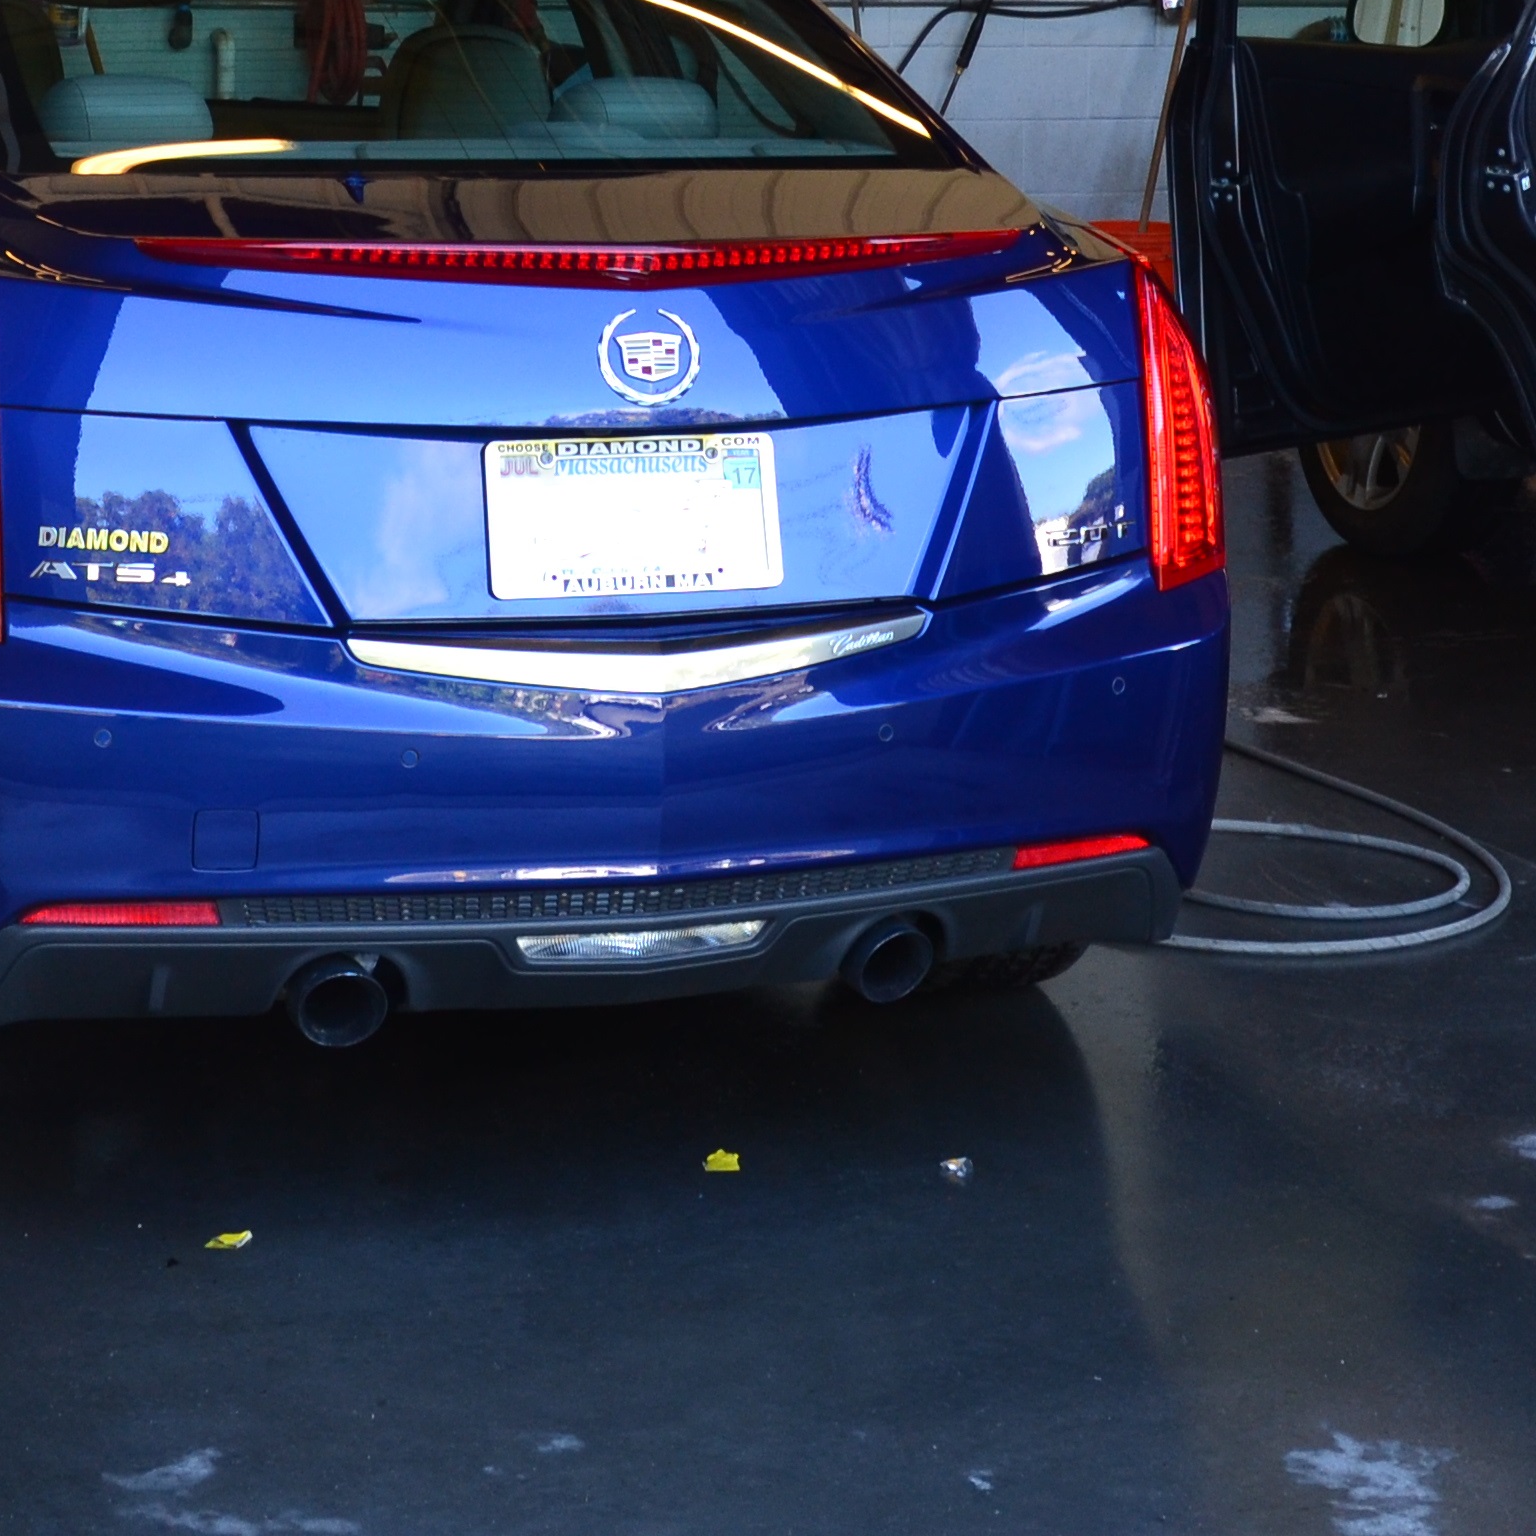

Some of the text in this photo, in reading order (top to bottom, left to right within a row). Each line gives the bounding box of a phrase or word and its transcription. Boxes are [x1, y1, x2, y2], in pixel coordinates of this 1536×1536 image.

[498, 443, 548, 453] CHOOSE
[557, 439, 701, 456] DIAMOND
[500, 456, 539, 476] JUL
[733, 467, 756, 484] 17
[38, 526, 169, 554] DIAMOND
[564, 575, 661, 593] AUBURN
